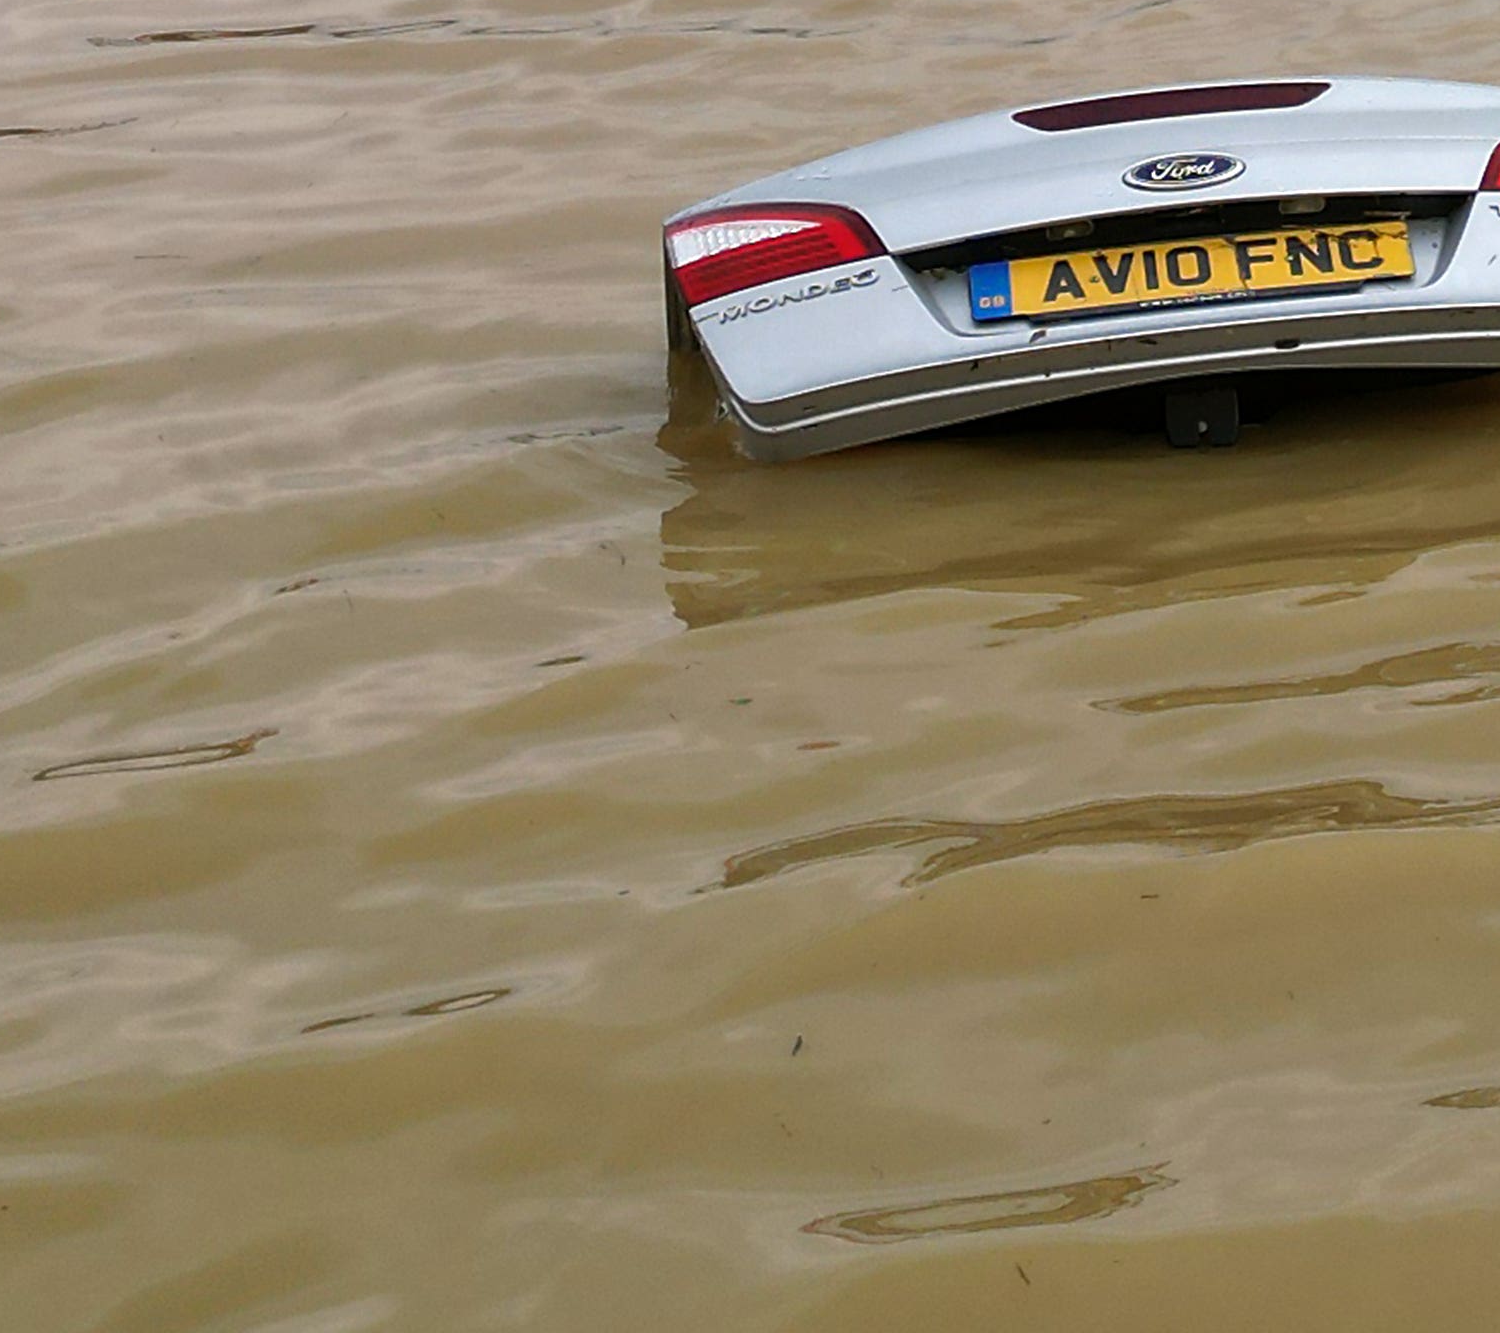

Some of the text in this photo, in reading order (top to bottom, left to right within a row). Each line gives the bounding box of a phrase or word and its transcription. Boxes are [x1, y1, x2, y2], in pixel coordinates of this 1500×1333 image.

[1151, 157, 1215, 180] Ford
[1043, 230, 1385, 303] AV10 FNC
[720, 269, 880, 324] MONDEO
